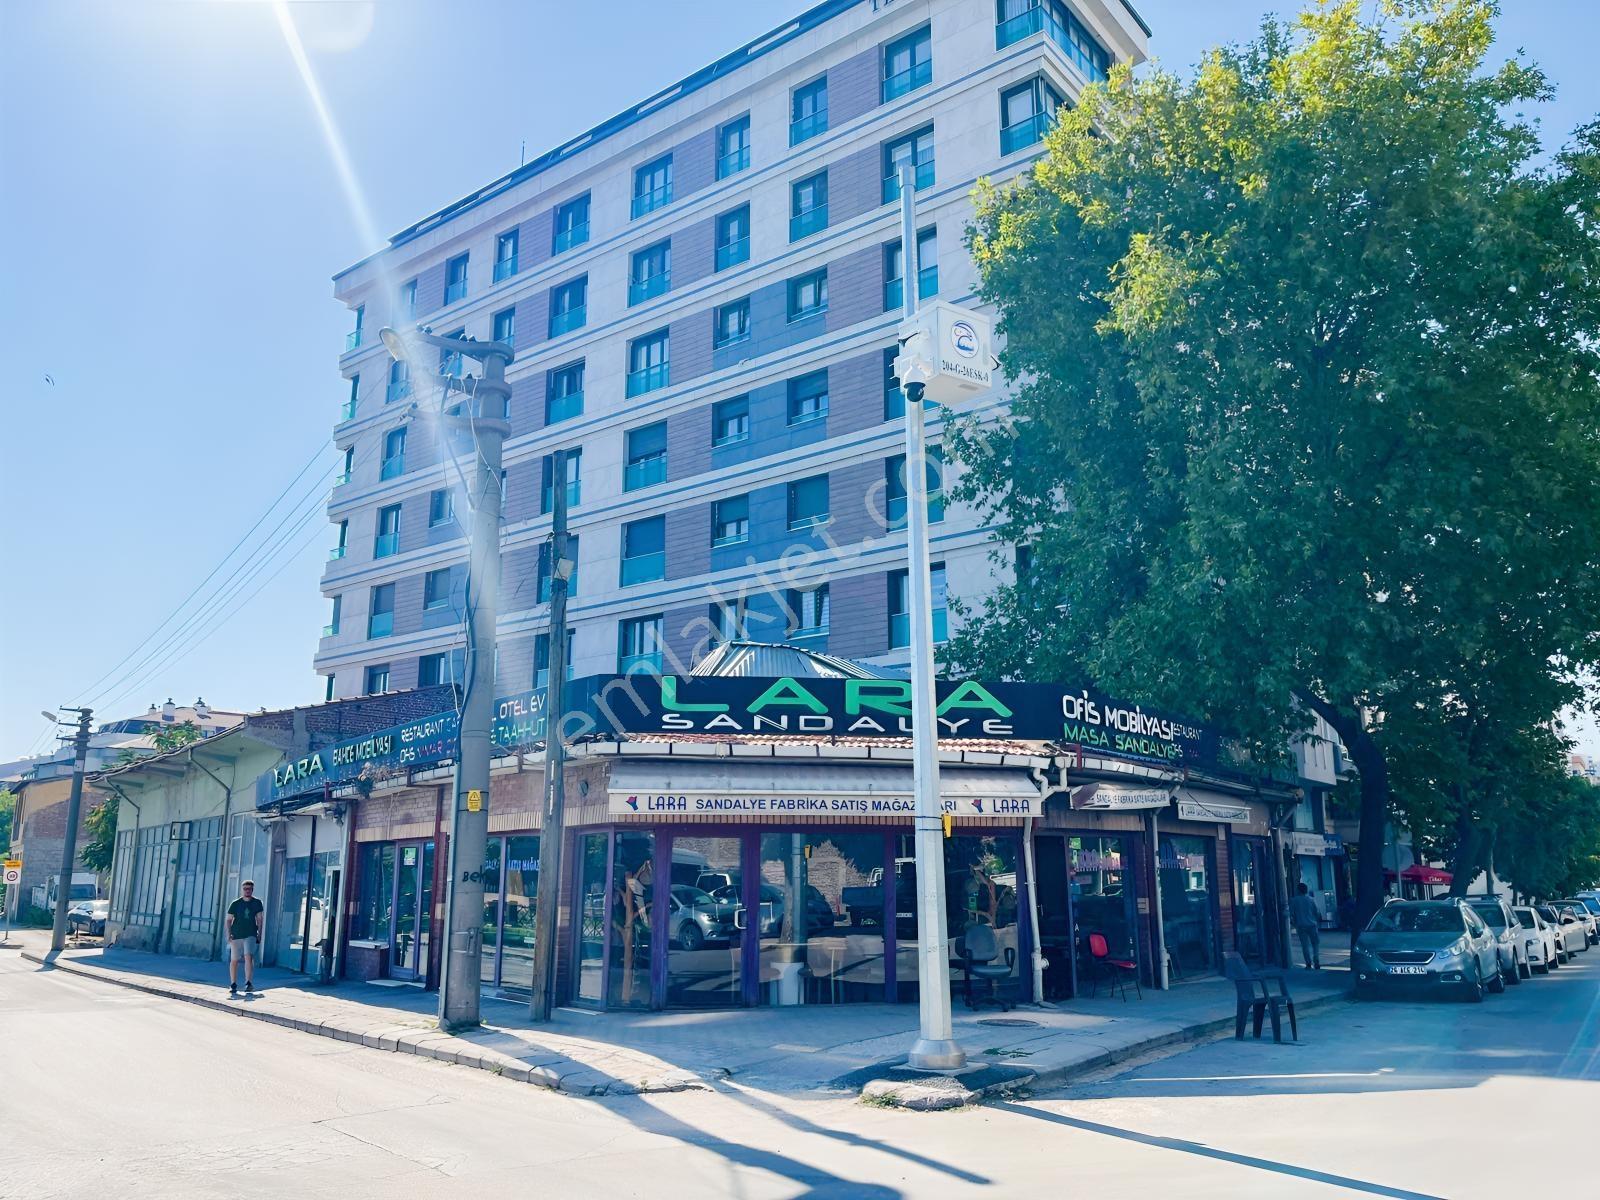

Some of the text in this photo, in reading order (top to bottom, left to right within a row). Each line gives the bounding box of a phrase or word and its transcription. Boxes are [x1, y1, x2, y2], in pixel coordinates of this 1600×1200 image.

[500, 699, 528, 719] OTEL
[661, 675, 1013, 717] LARA
[661, 713, 1014, 735] SANDALYE
[1063, 722, 1110, 747] MASA
[1115, 734, 1176, 759] SANDALYE
[274, 753, 324, 788] LARA
[648, 795, 1030, 814] LARA SANDALYE FABRİKA SATIŞ MAĞAZRI LARA
